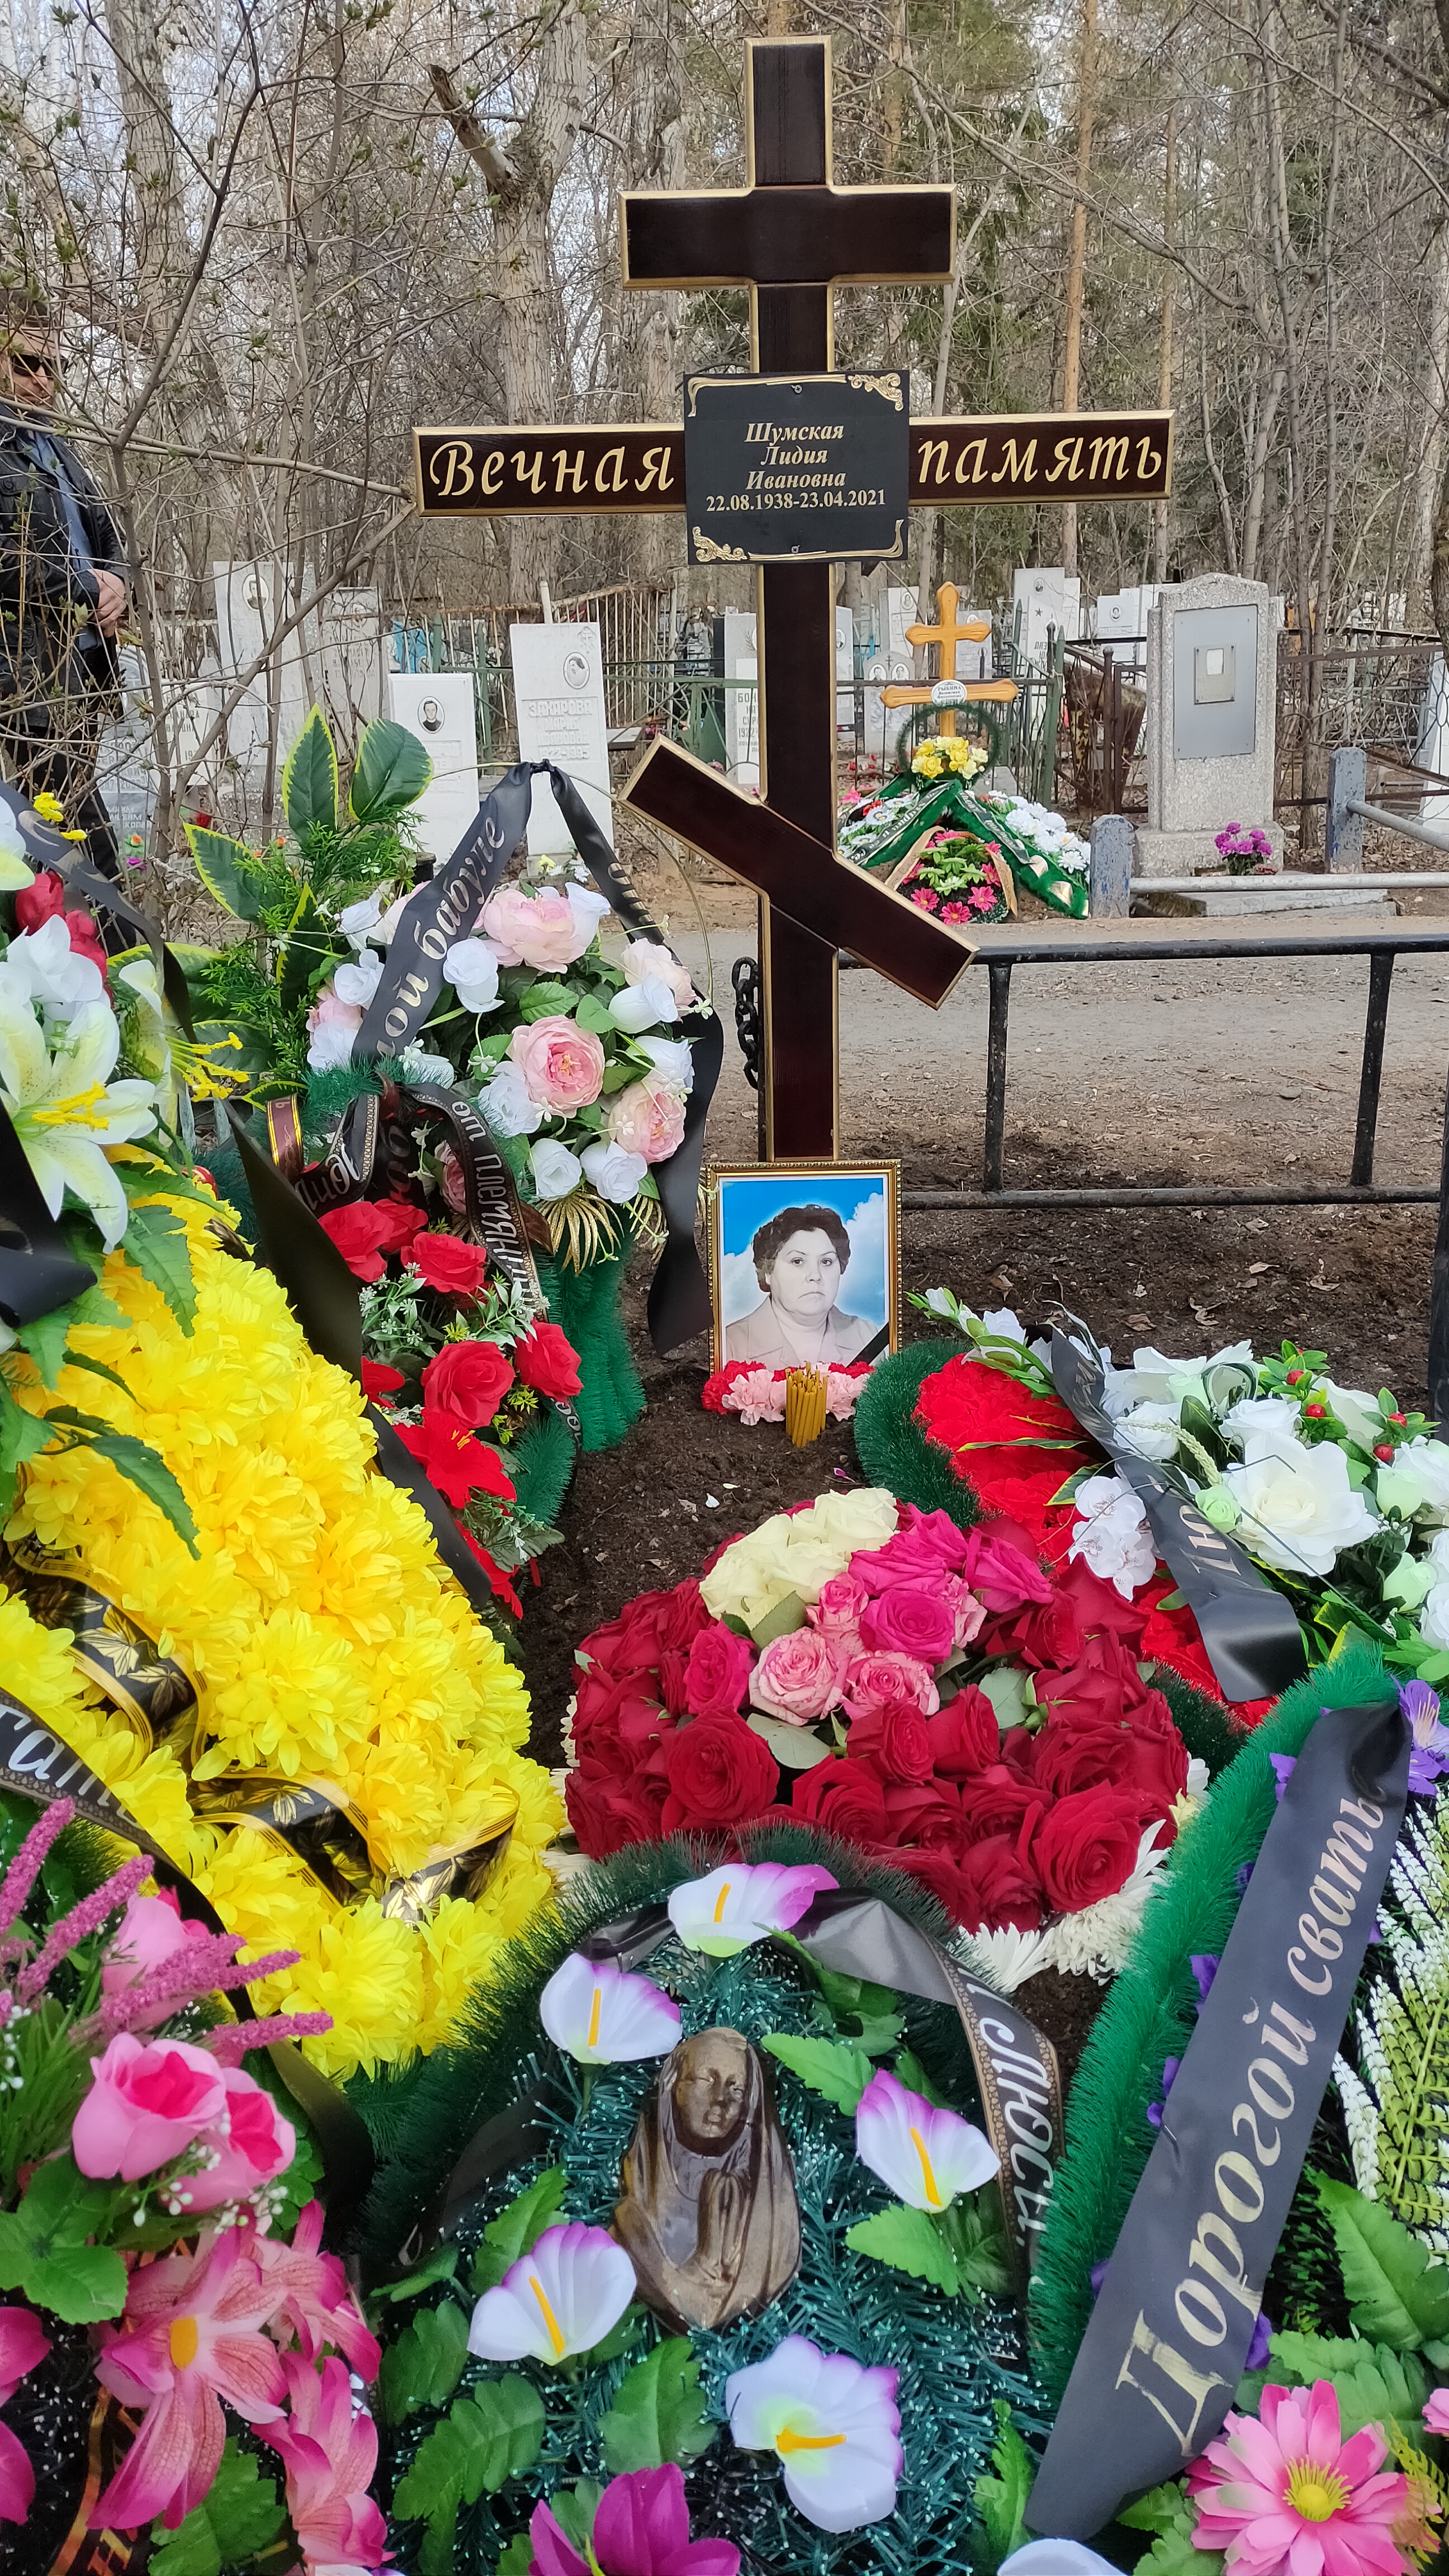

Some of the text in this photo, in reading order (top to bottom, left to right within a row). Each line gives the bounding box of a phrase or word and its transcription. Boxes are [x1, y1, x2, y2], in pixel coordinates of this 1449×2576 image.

[744, 422, 845, 446] Шумская
[430, 436, 1162, 496] Вечная память
[760, 446, 828, 466] Лидия
[745, 470, 847, 490] Ивановна
[705, 489, 886, 512] 22.08.1938-23.04.2021
[413, 816, 504, 960] бабуле
[1115, 1997, 1317, 2457] Дорогой
